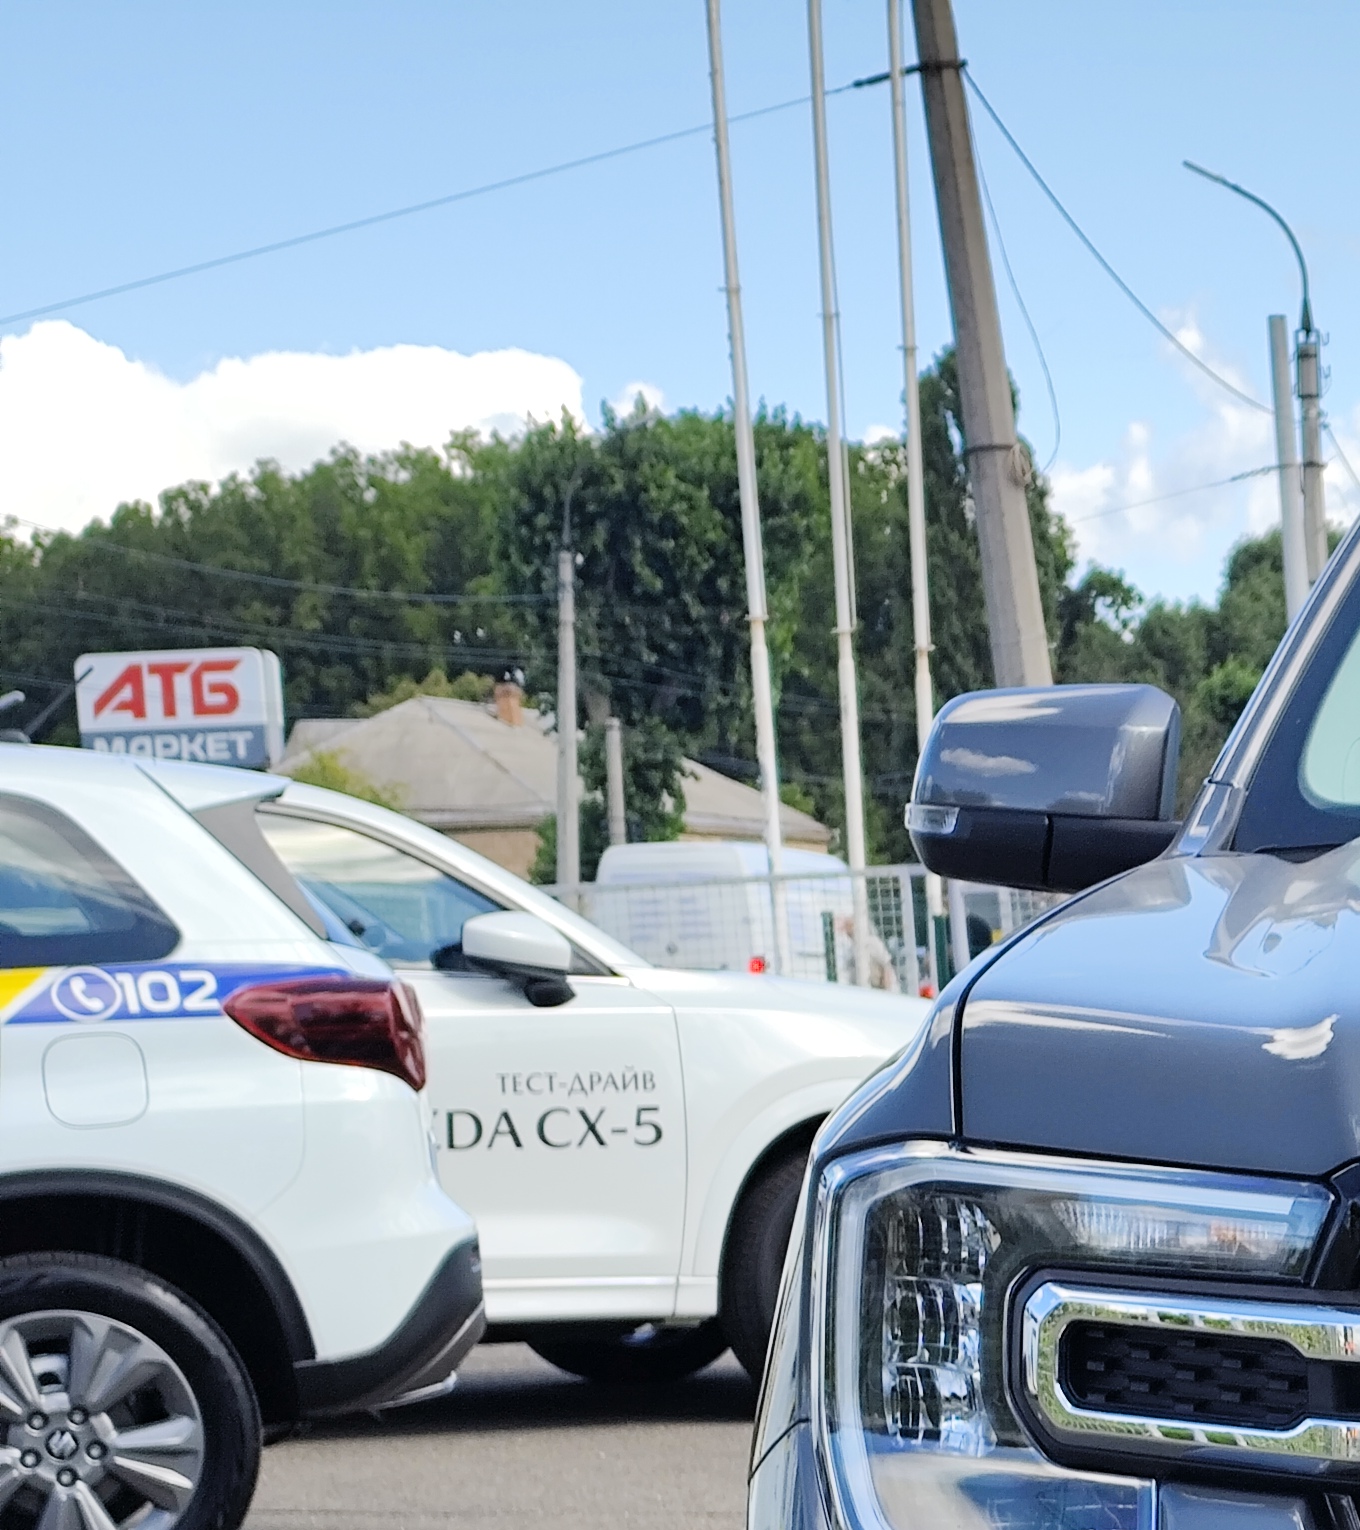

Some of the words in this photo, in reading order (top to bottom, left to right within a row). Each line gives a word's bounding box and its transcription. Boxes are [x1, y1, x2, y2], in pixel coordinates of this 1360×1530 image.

[94, 659, 242, 720] АТБ
[115, 968, 222, 1014] 102
[497, 1065, 656, 1097] ТЕСТ-ДРАЙВ
[432, 1108, 524, 1151] DA
[536, 1105, 663, 1149] CX-5
